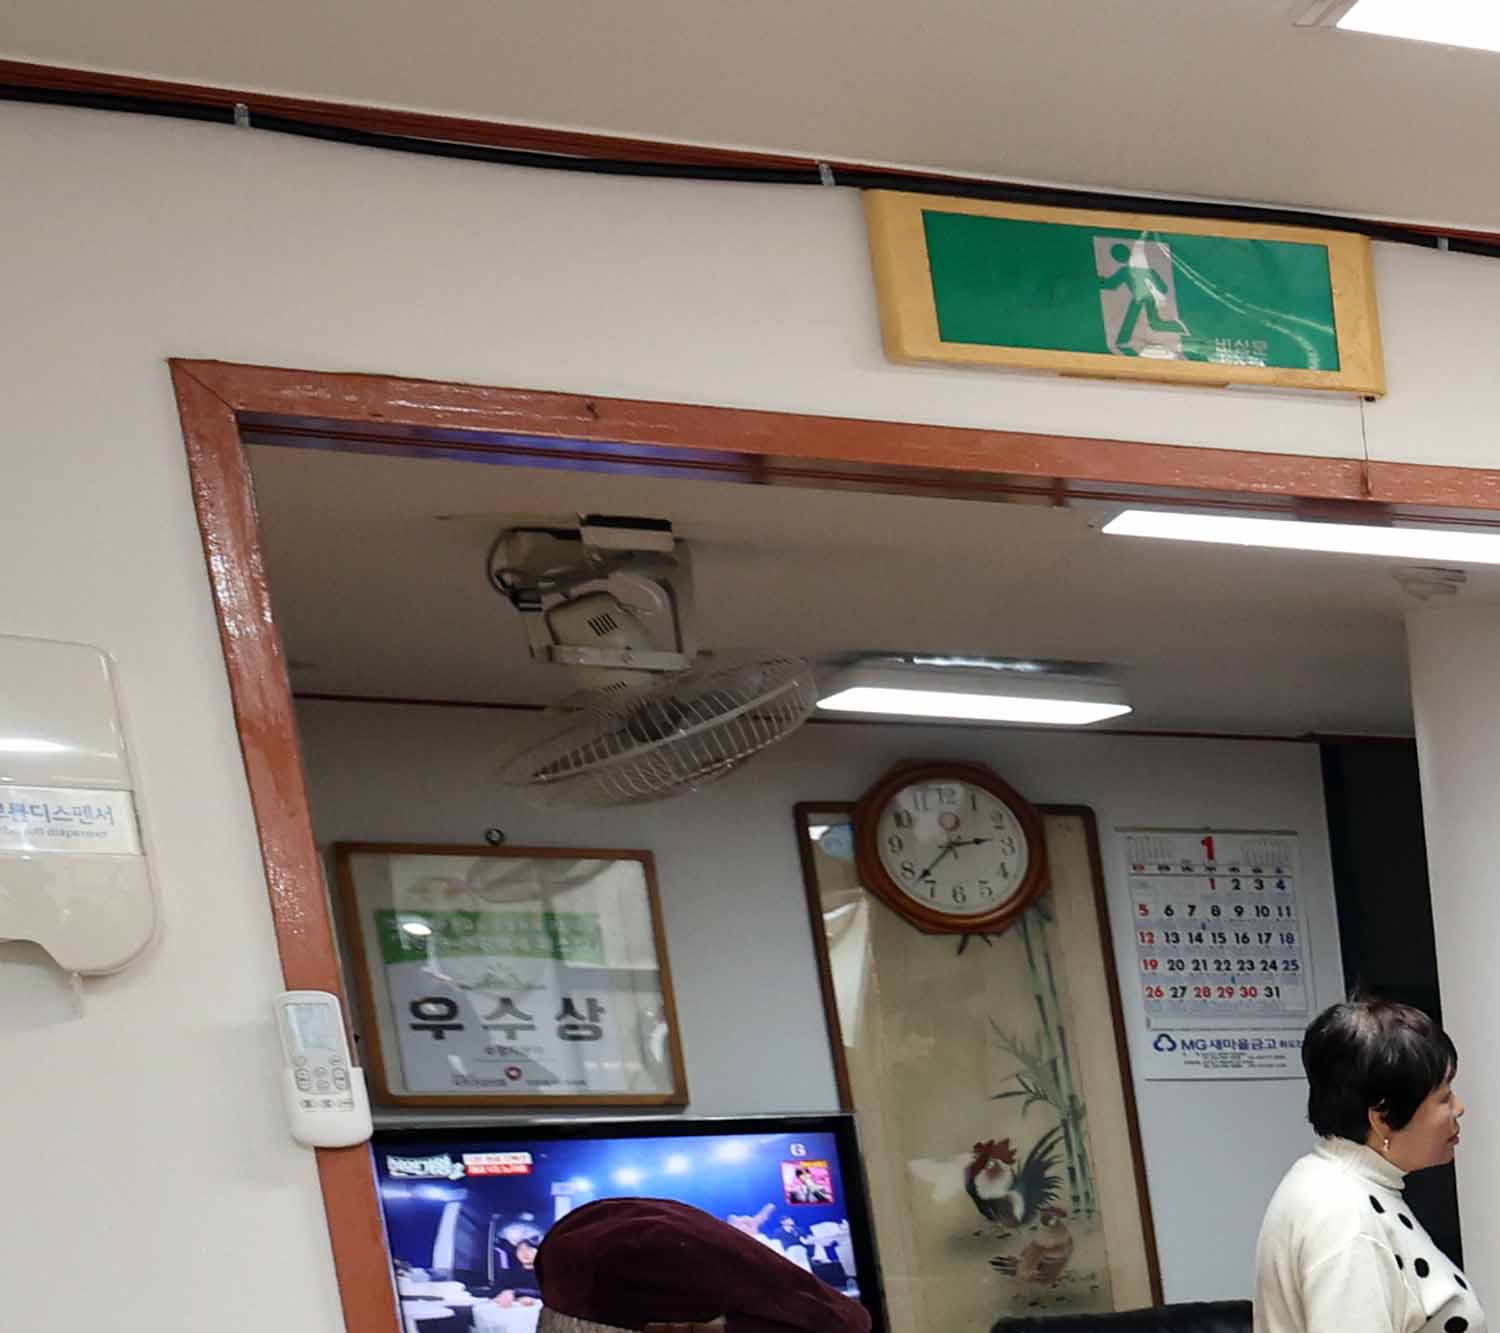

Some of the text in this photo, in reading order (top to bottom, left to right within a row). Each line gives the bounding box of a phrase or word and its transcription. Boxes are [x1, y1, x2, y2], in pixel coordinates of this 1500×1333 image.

[894, 810, 912, 828] 10
[888, 836, 903, 854] 9
[1001, 837, 1015, 856] 3
[1201, 836, 1215, 860] 1
[901, 862, 915, 878] 8
[924, 880, 936, 898] 7
[978, 880, 993, 897] 5
[1208, 878, 1287, 891] 1 2 3 4
[952, 886, 967, 904] 6
[1138, 903, 1292, 918] 5 6 7 8 9 10 11
[1139, 931, 1295, 945] 12 13 14 15 16 17 18
[1142, 958, 1300, 972] 19 20 21 22 23 24 25
[1145, 985, 1280, 999] 26 27 28 29 30 31
